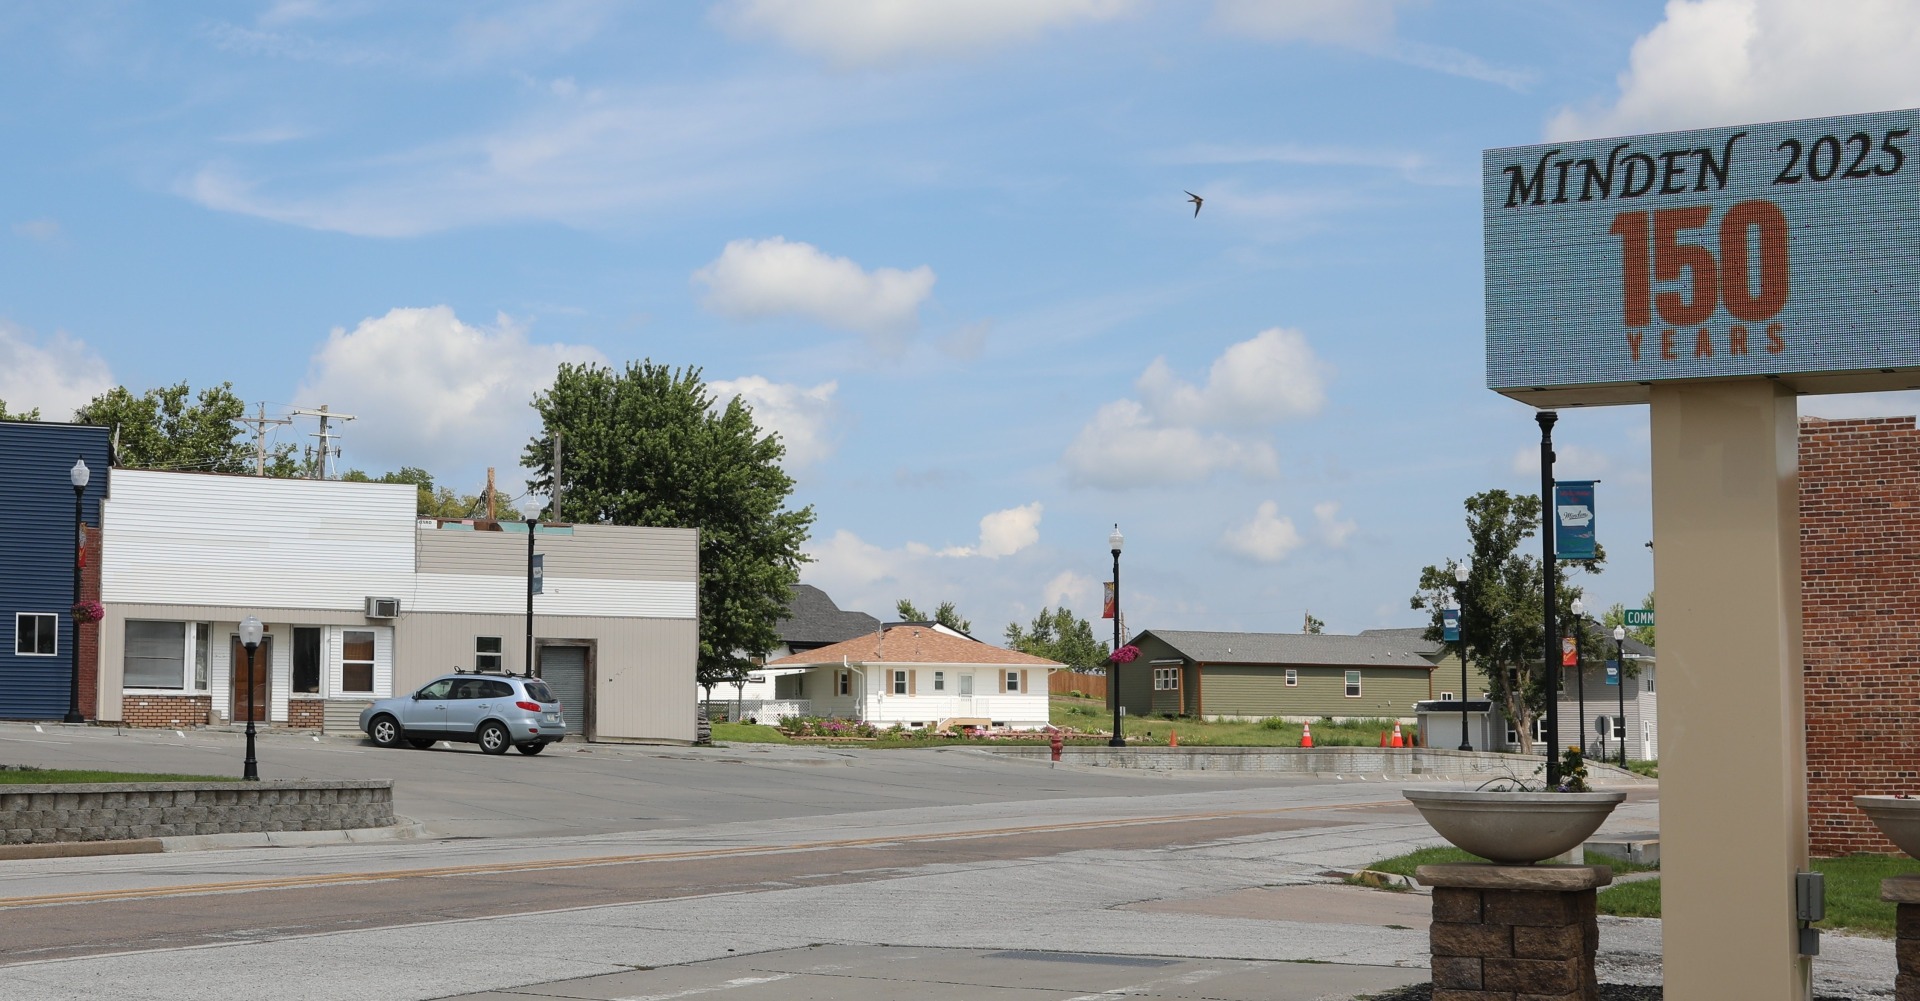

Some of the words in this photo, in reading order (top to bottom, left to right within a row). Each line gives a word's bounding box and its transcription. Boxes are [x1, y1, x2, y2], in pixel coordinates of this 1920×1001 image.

[1503, 132, 1747, 208] MINDEN
[1773, 127, 1910, 186] 2025
[1609, 199, 1790, 327] 150
[1626, 322, 1786, 362] YEARS
